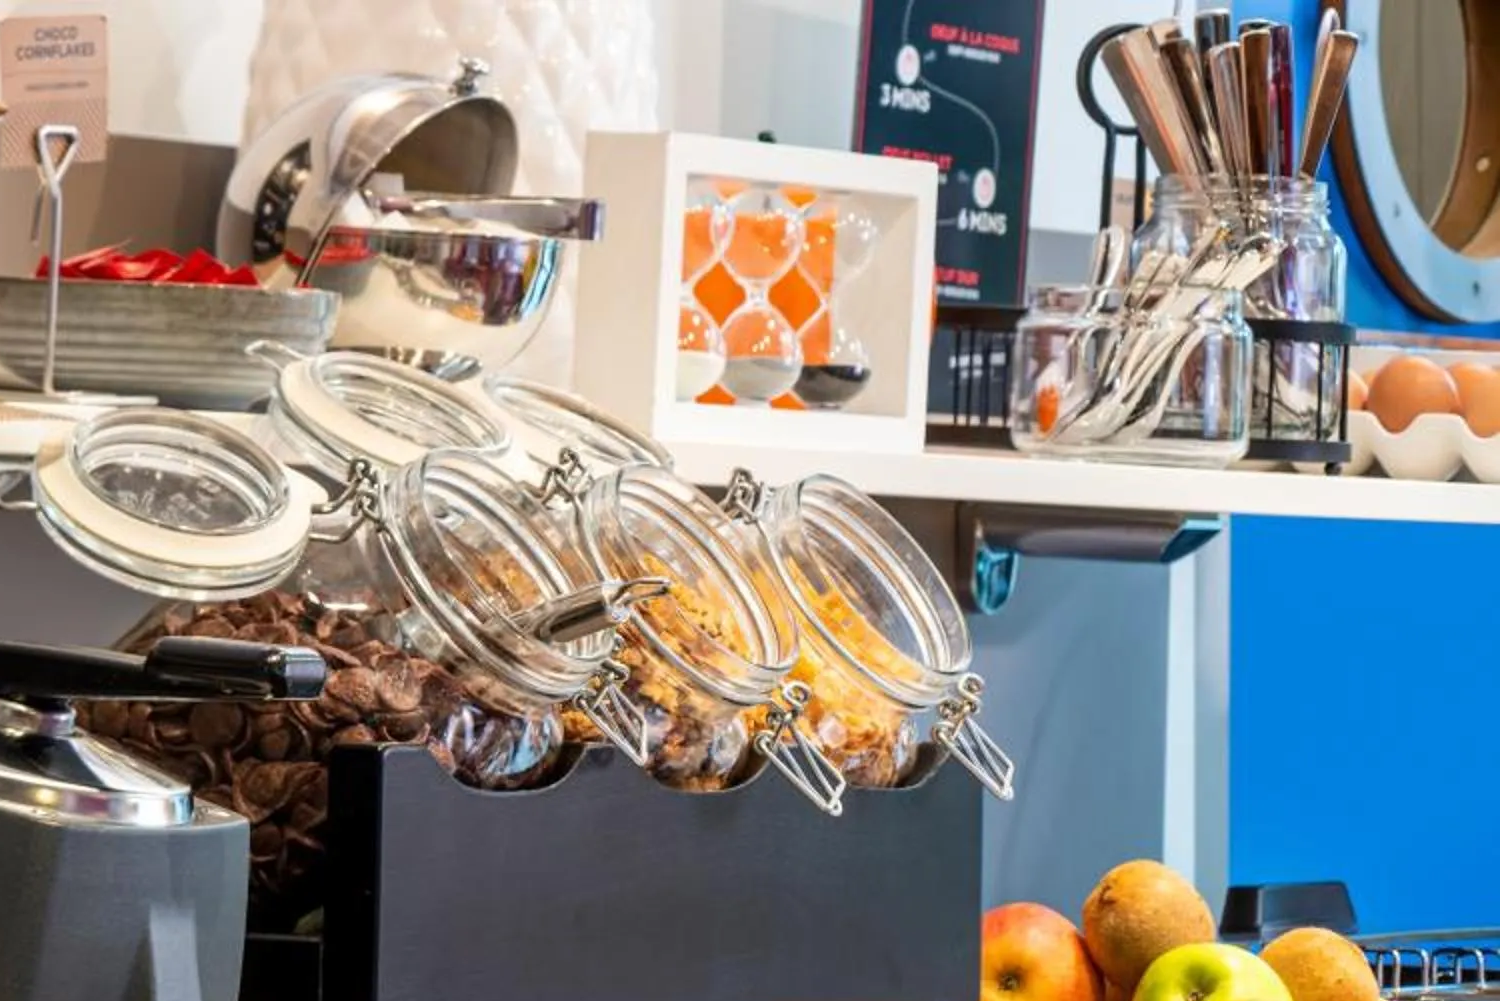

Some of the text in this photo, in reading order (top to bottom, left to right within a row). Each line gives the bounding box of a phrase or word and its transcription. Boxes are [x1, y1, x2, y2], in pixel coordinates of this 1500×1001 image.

[34, 26, 79, 42] CHOCO
[15, 42, 96, 62] CORNFLAKES
[880, 83, 931, 113] 3 MINS
[957, 208, 1007, 236] 6 MINS
